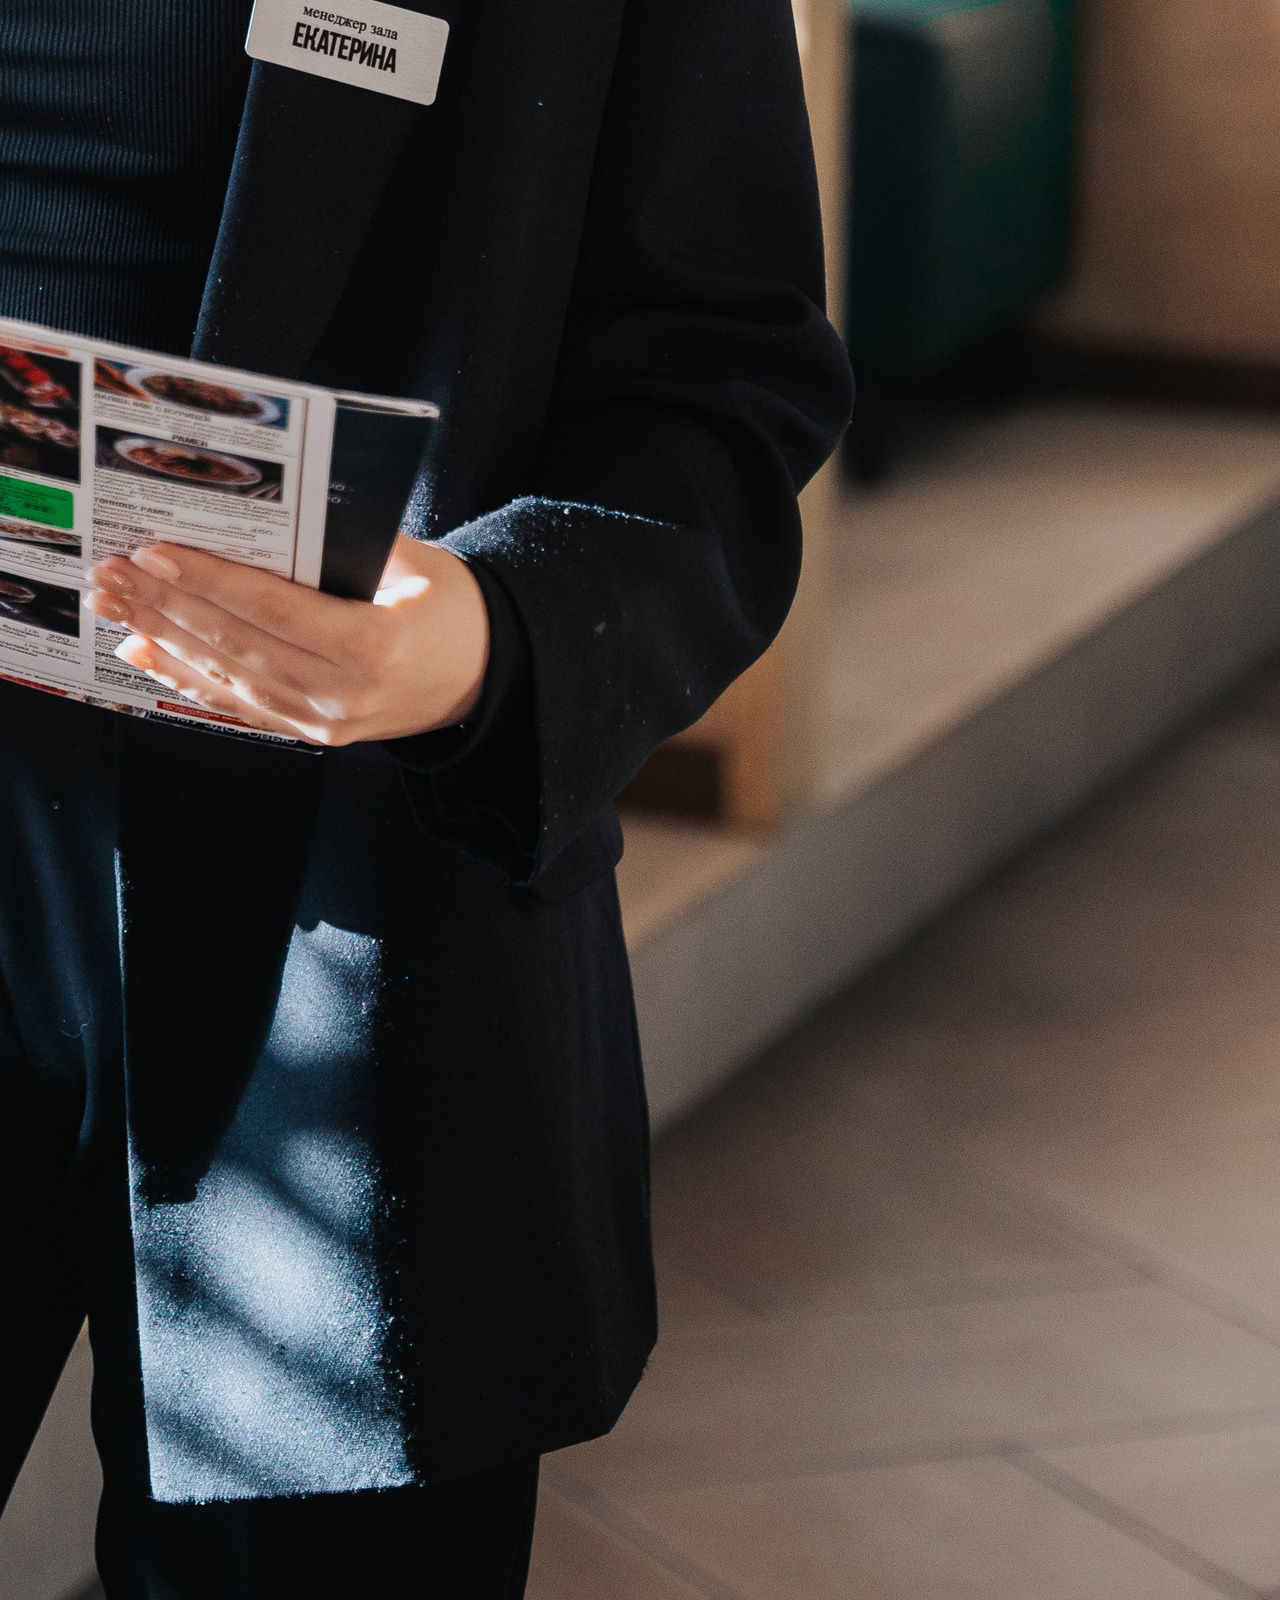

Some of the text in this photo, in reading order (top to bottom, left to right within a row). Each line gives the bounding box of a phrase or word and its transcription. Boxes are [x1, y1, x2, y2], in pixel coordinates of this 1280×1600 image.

[302, 6, 398, 40] менеджер зала
[292, 22, 397, 73] ЕКАТЕРИНА
